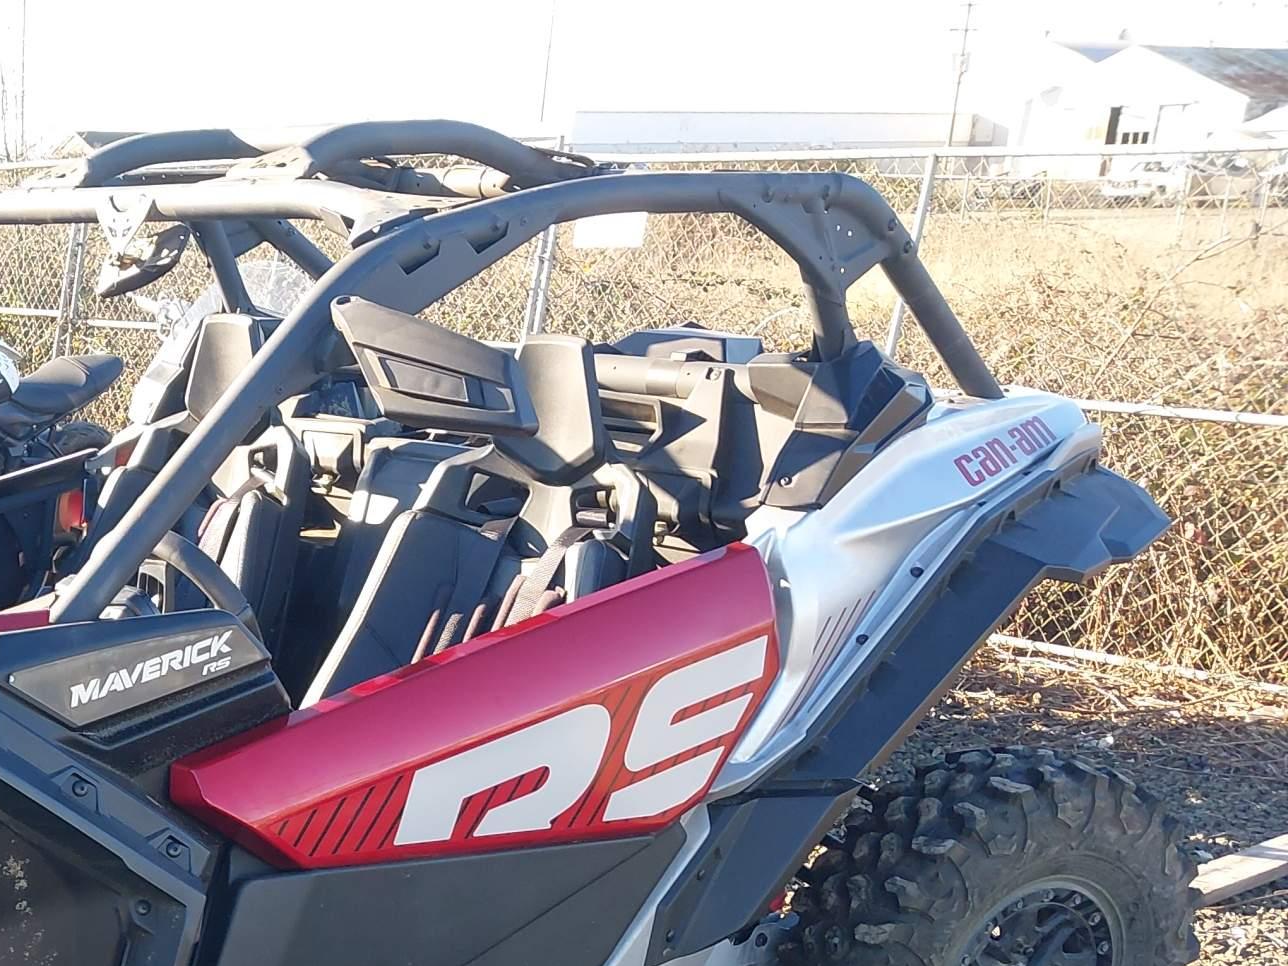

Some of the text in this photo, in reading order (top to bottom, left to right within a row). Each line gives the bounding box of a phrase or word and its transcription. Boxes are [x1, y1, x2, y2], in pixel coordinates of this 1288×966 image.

[954, 416, 1057, 487] can-am
[70, 630, 233, 708] MAVERICK
[202, 656, 232, 676] RS
[394, 634, 768, 846] RS
